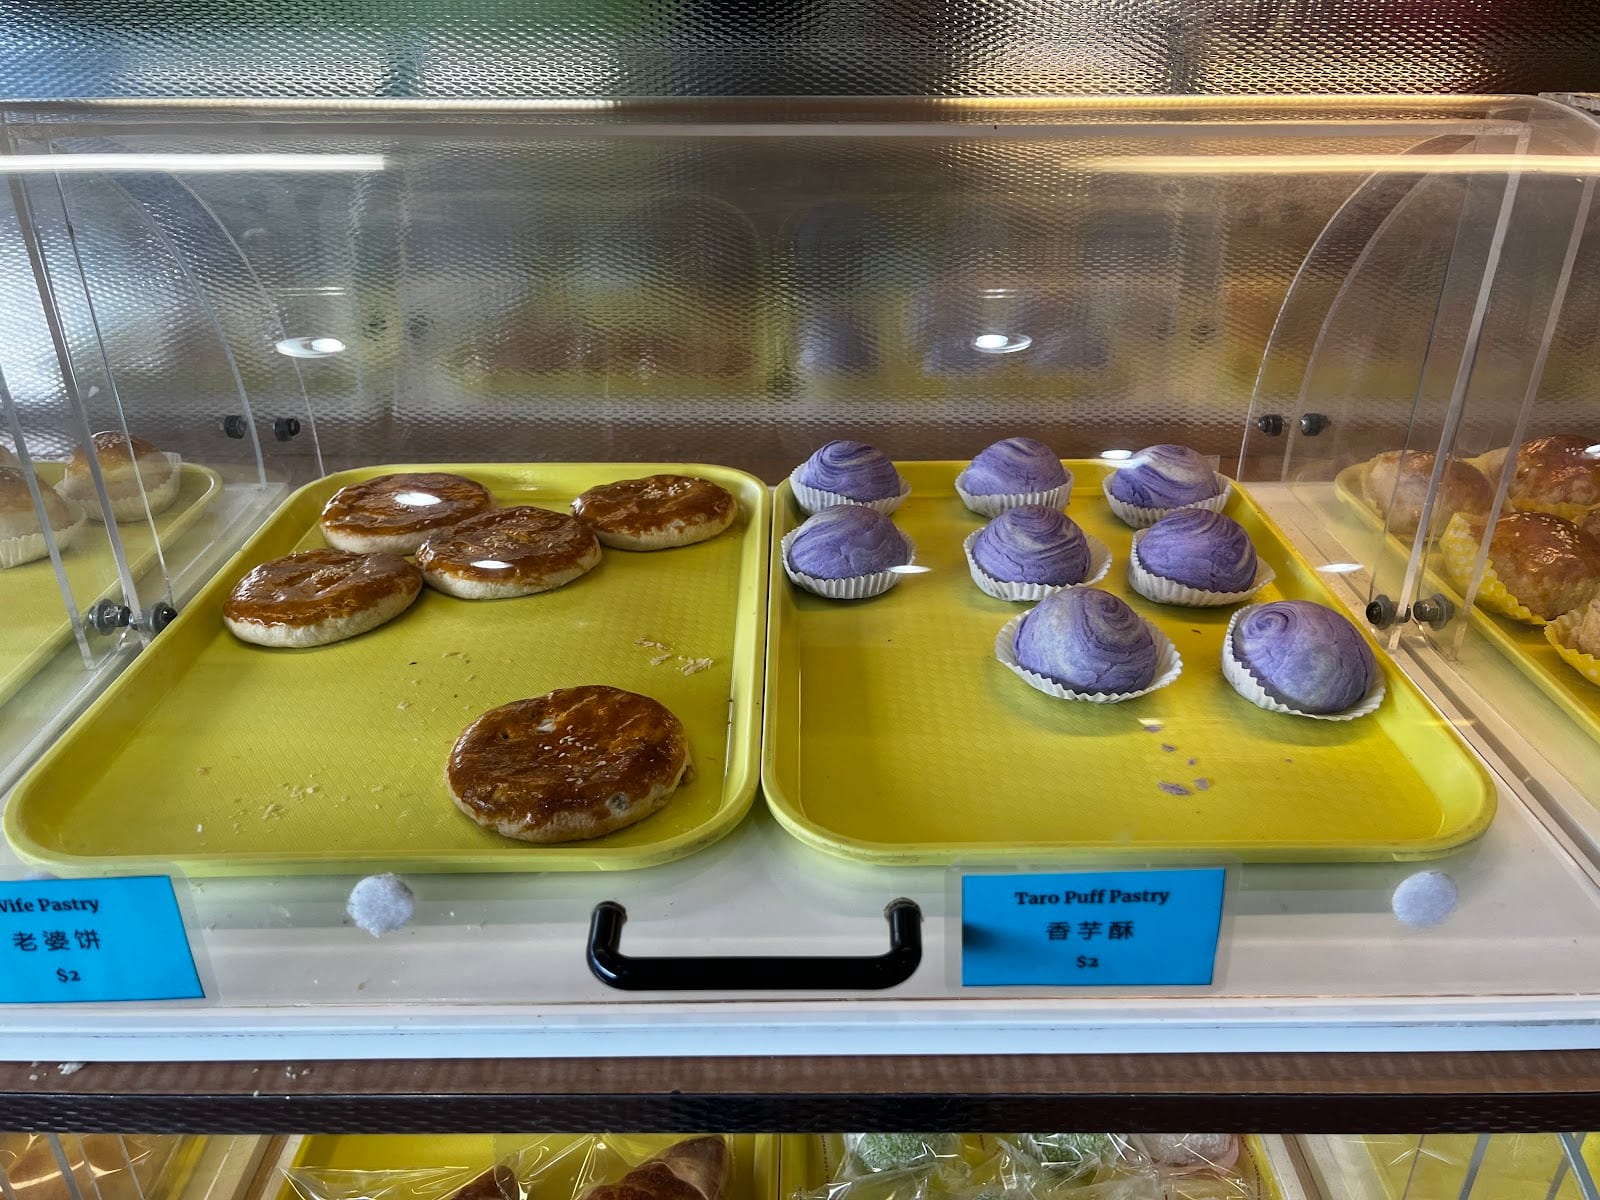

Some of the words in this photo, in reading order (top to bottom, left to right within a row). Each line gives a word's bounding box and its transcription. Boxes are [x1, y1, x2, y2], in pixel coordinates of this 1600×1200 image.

[1015, 891, 1060, 905] Taro
[1064, 889, 1107, 904] Puff
[1110, 889, 1170, 906] Pastry
[38, 898, 98, 914] Pastry
[1046, 920, 1134, 940] 香芋酥
[13, 928, 100, 951] 老婆饼
[1076, 955, 1099, 968] $2
[56, 968, 81, 983] $2
